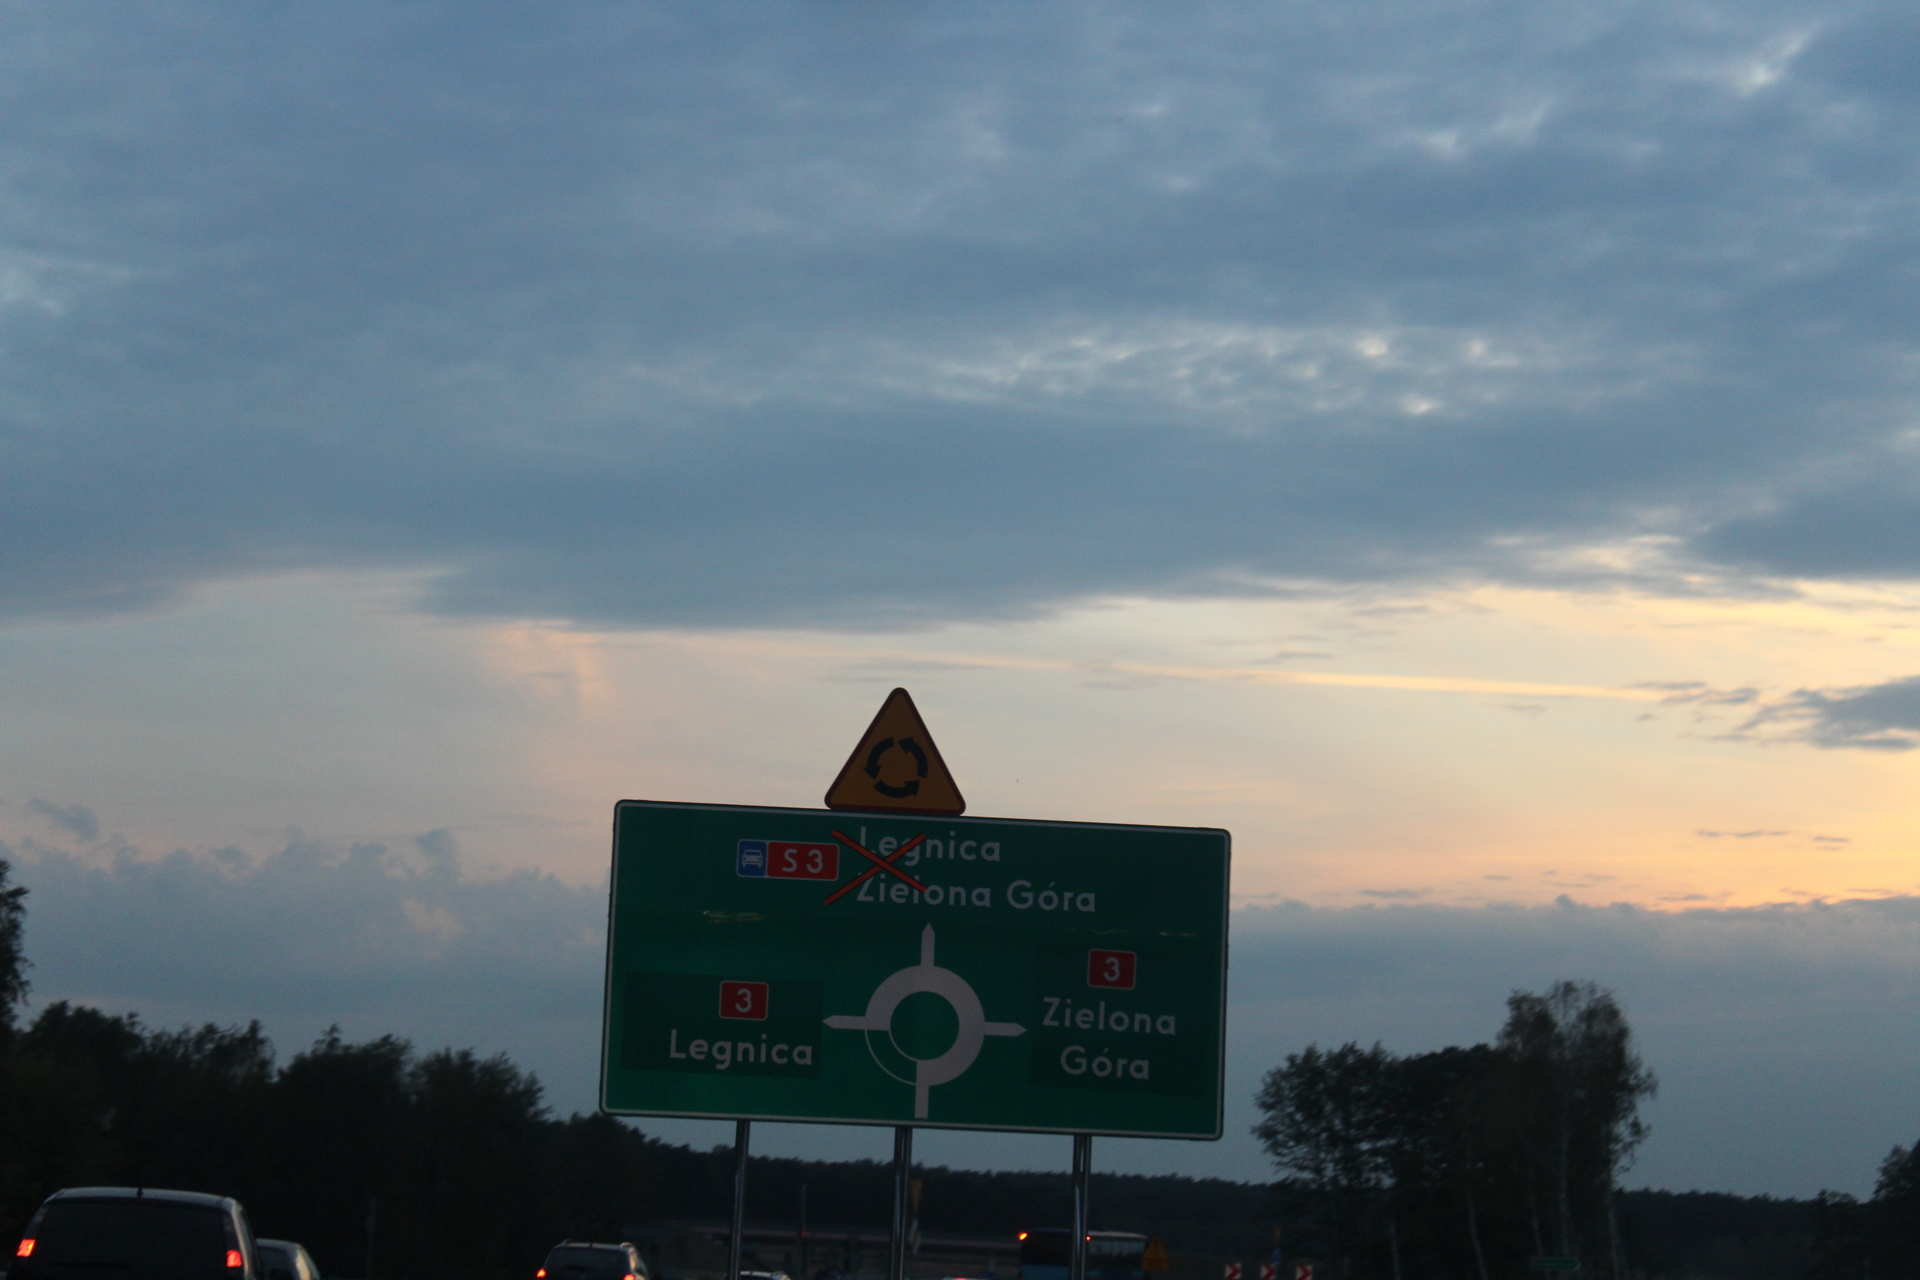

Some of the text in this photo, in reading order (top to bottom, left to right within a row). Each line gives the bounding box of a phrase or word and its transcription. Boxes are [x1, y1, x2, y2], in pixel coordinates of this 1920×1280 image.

[859, 826, 1001, 867] Legnica
[856, 872, 1096, 913] Zielona Góra
[1103, 956, 1121, 982] 3
[735, 987, 752, 1013] 3
[1042, 996, 1176, 1036] Zielona
[669, 1028, 813, 1071] Legnica
[1060, 1045, 1149, 1080] Góra
